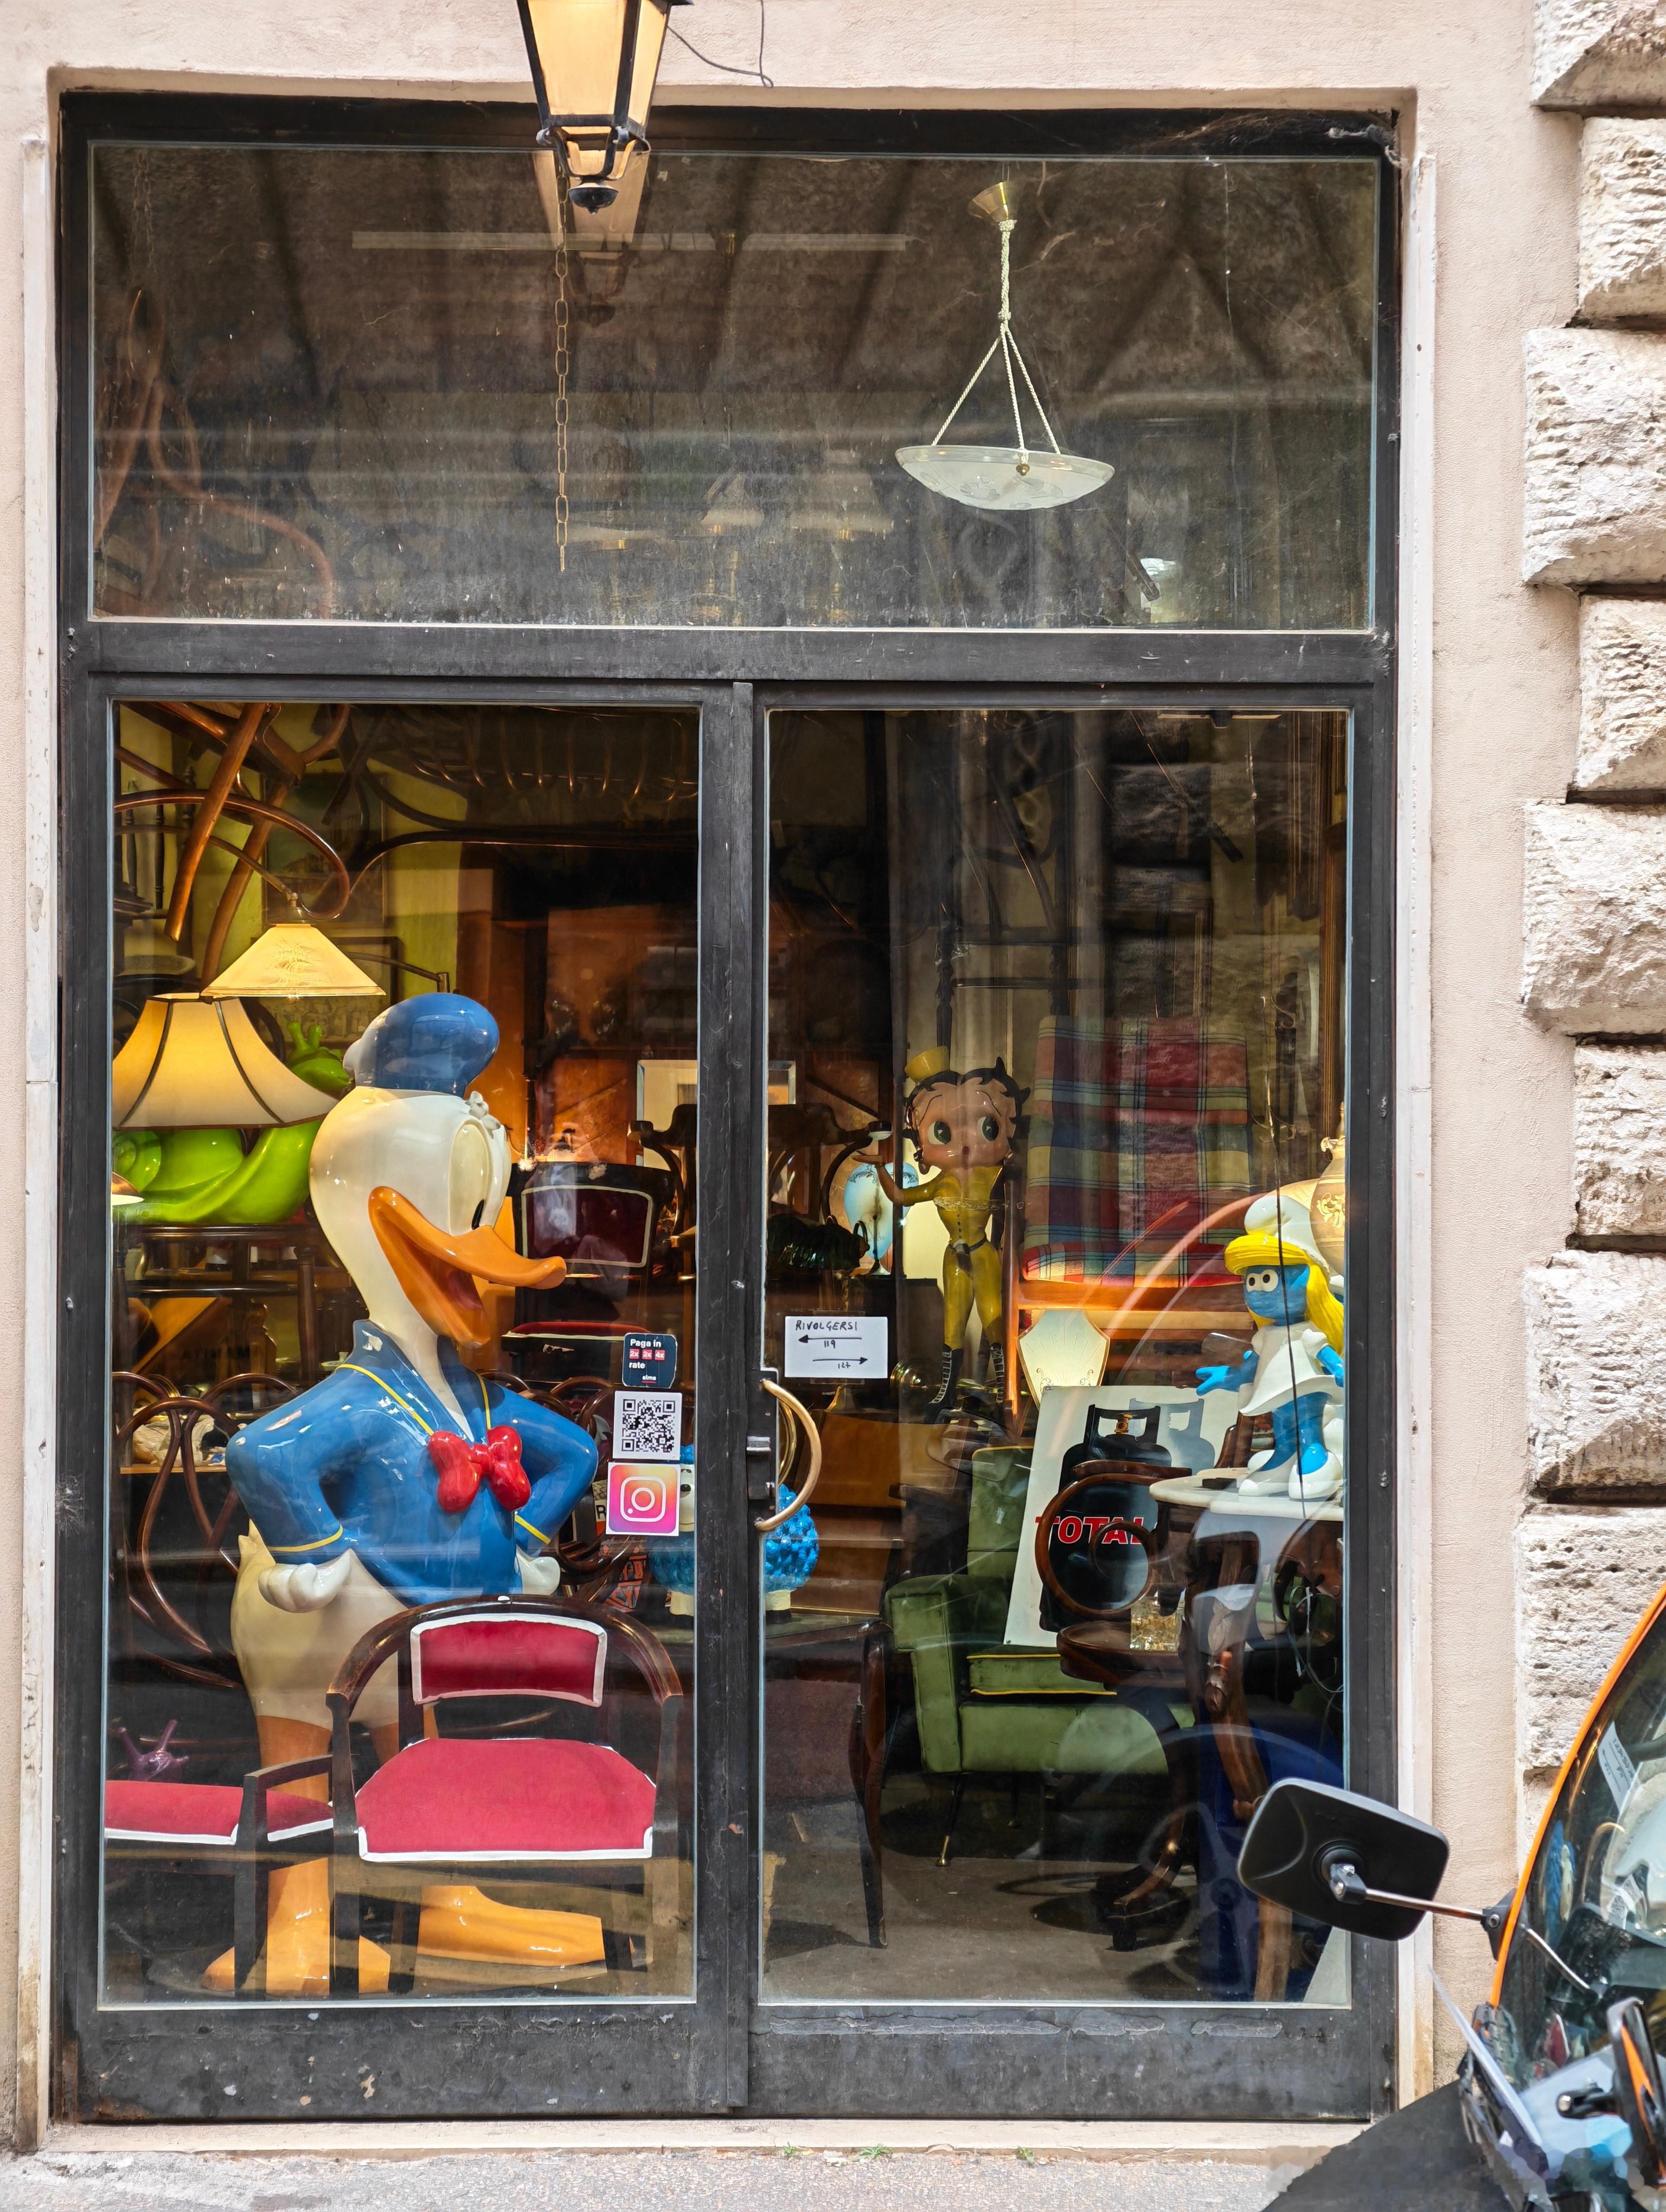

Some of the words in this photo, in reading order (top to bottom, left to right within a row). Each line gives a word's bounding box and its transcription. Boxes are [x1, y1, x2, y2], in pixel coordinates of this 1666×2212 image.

[796, 1320, 857, 1331] RIVOLGERSI
[630, 1339, 651, 1348] Paga
[824, 1340, 836, 1348] 119
